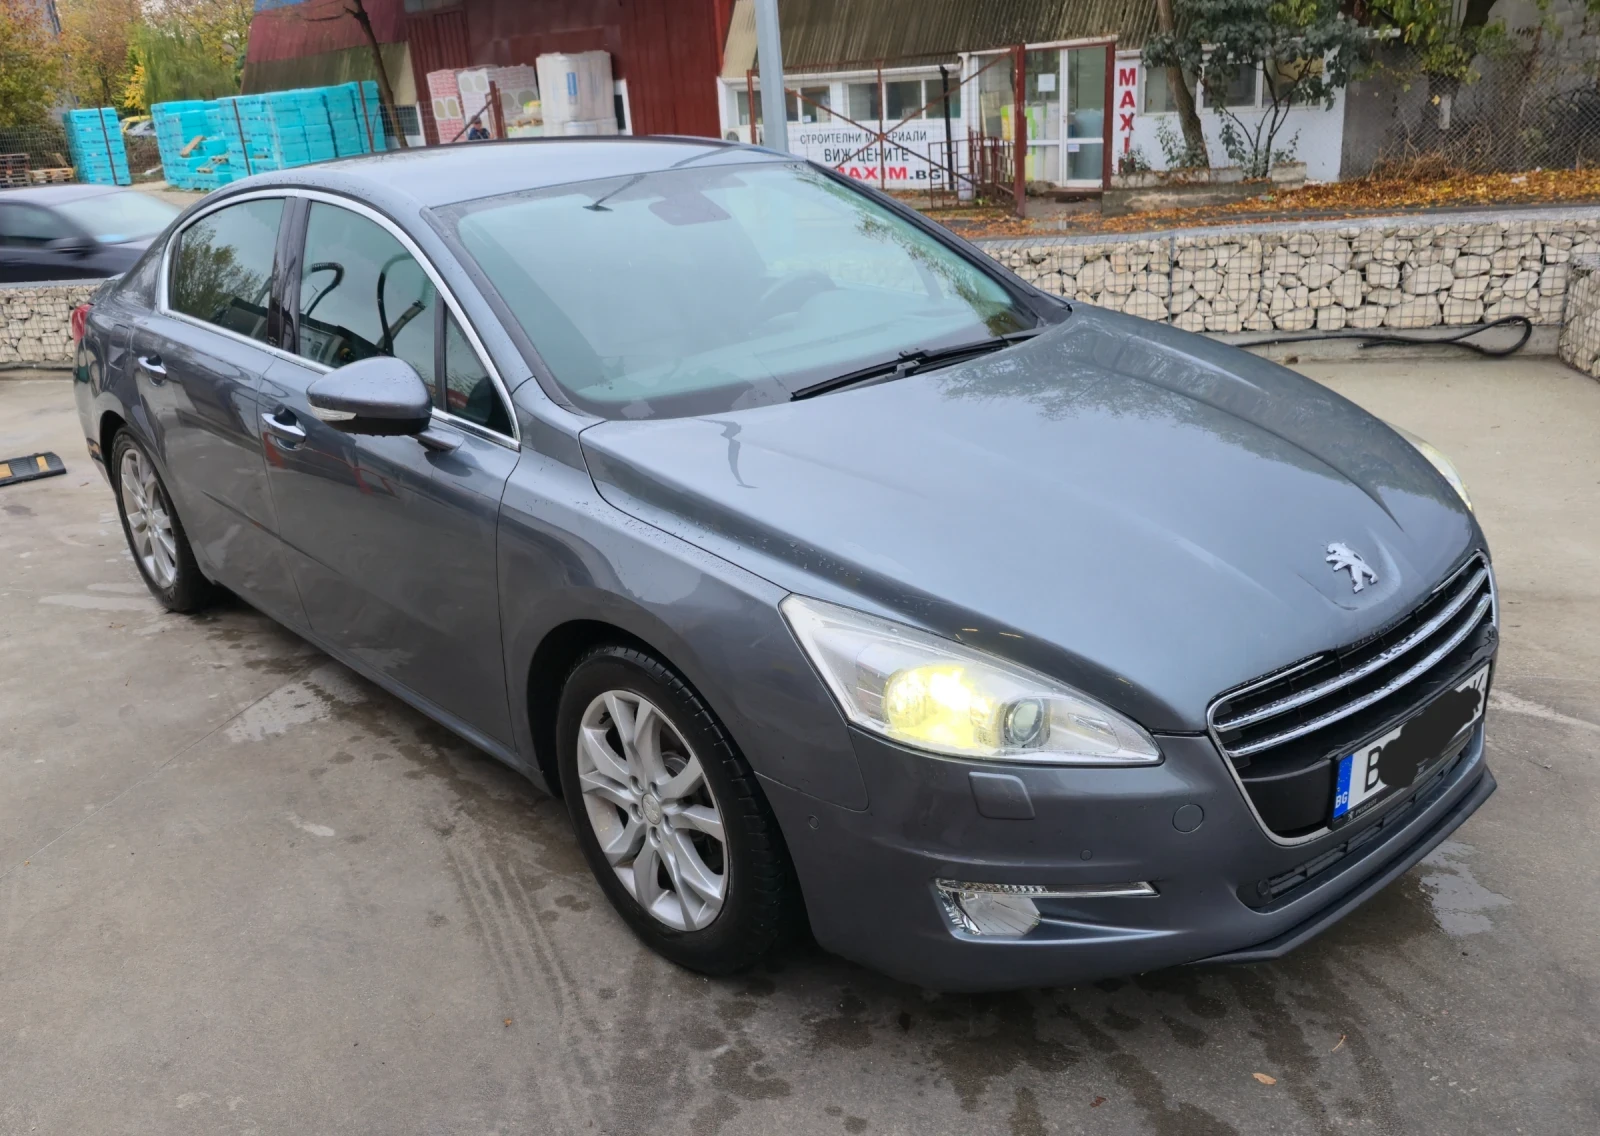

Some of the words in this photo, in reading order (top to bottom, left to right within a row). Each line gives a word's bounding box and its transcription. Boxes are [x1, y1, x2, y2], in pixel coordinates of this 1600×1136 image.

[800, 133, 861, 145] СТРОИТЕЛНИ
[865, 131, 927, 144] МЕРИАЛИ
[824, 148, 851, 163] ВИЖ
[857, 147, 909, 164] ЦЕНИТЕ
[1335, 791, 1348, 809] BG
